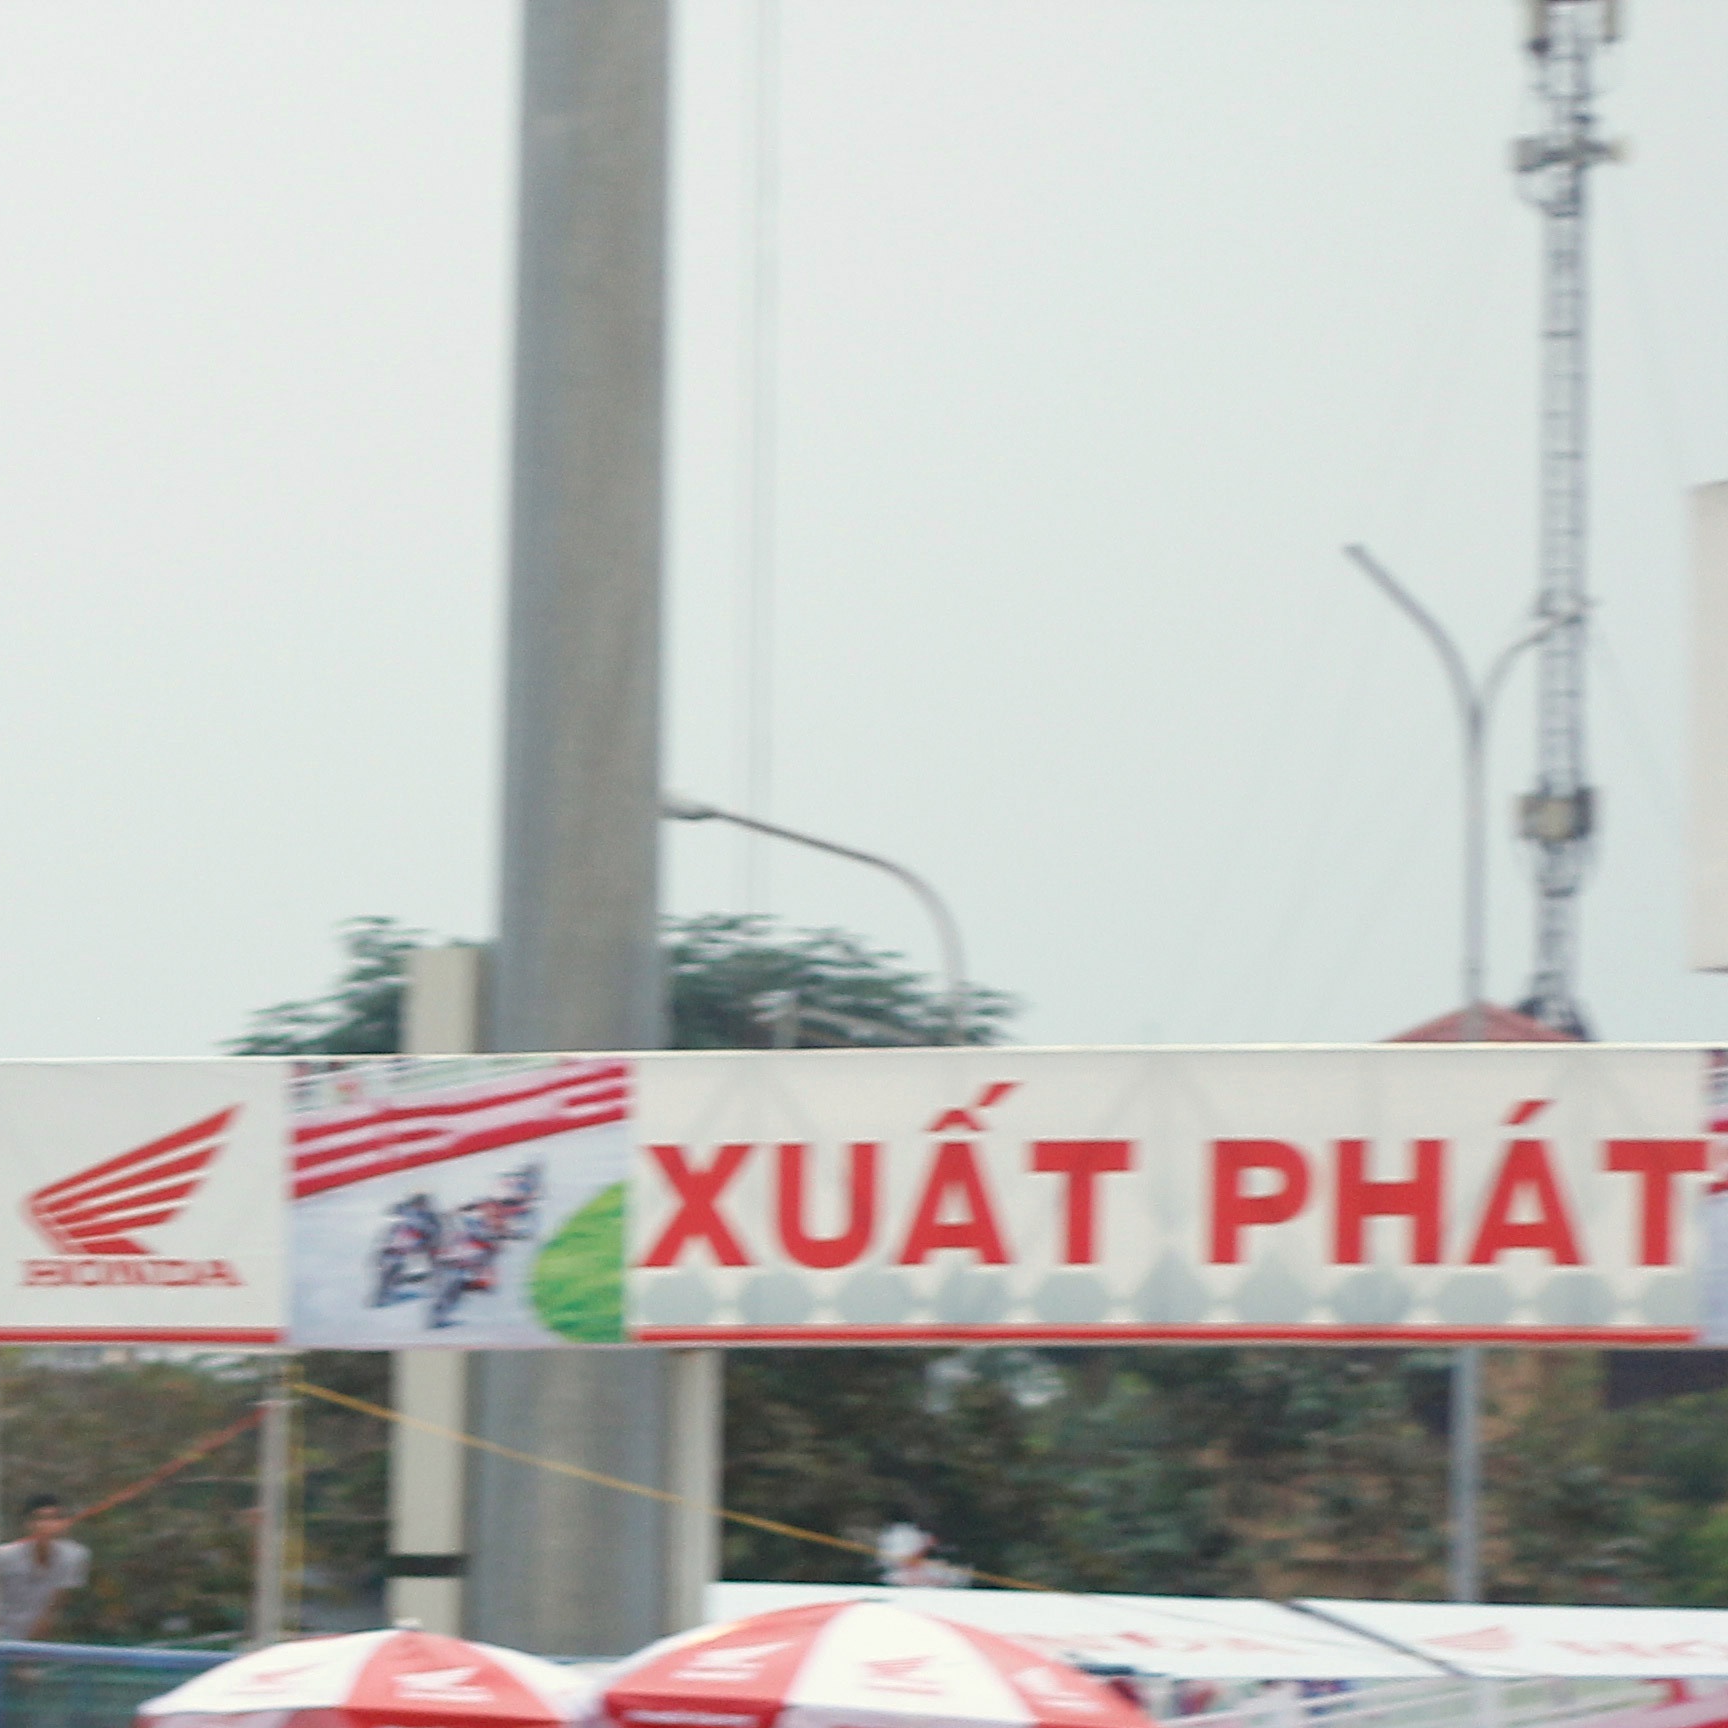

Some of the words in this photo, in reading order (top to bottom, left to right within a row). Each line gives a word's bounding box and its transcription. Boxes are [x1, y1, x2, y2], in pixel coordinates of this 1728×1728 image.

[634, 1081, 1135, 1269] XUẤT
[1202, 1098, 1709, 1268] PHÁT
[19, 1258, 246, 1287] HONDA
